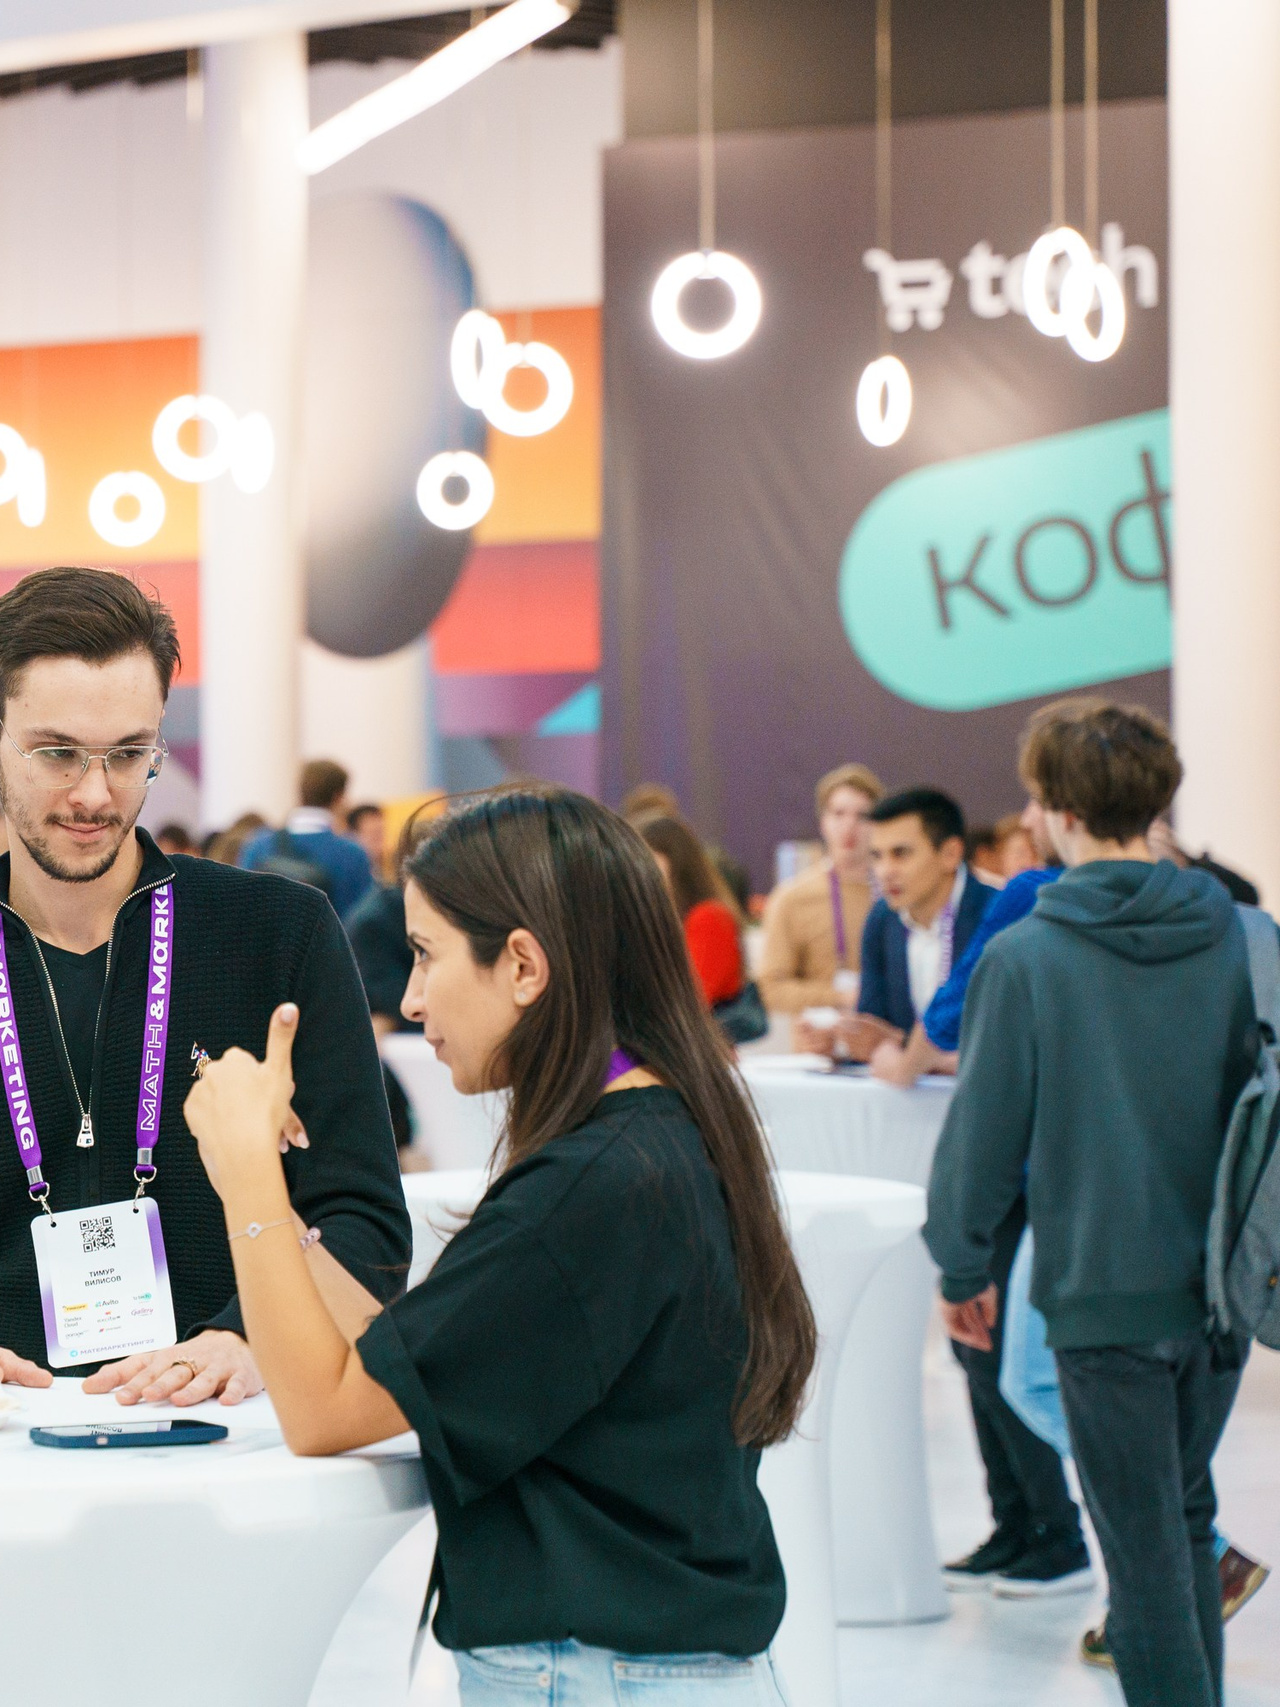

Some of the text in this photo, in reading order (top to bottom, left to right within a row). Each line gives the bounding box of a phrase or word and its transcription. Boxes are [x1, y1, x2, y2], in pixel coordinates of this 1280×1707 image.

[960, 222, 1158, 319] th
[89, 1268, 115, 1277] ТИМУР
[84, 1276, 122, 1287] ВИЛИСОВ
[131, 1308, 154, 1316] Gallery
